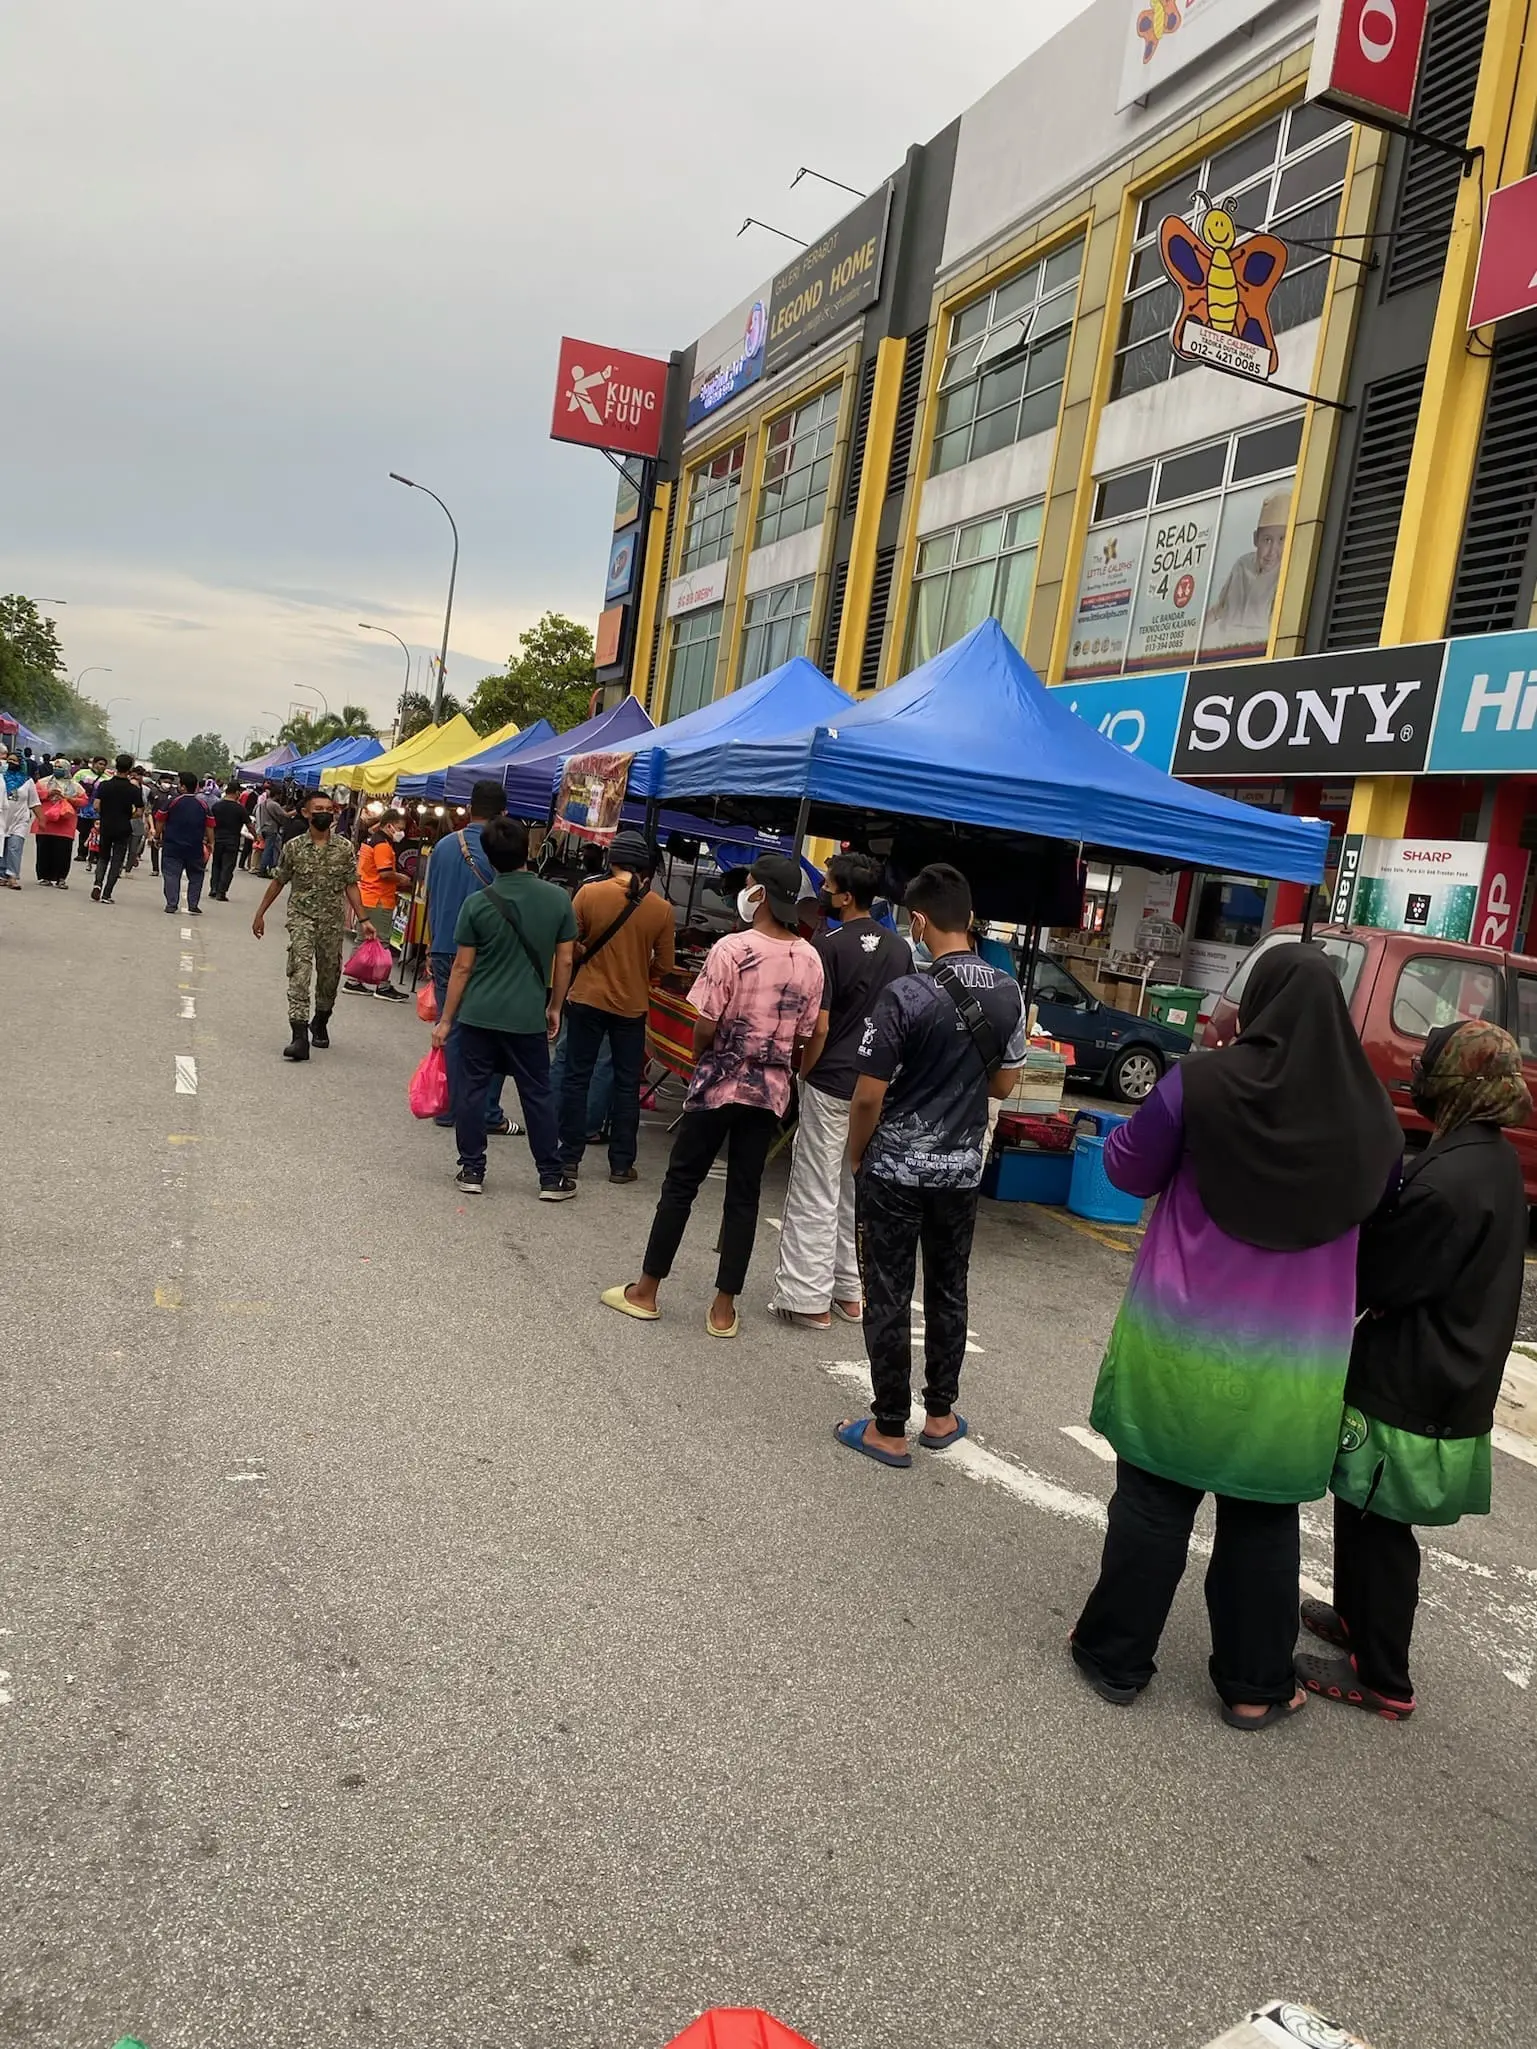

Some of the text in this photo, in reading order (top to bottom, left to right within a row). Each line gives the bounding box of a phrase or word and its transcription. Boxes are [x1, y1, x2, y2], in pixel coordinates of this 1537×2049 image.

[802, 231, 840, 273] PERABOT
[770, 279, 823, 340] LEGOND
[829, 236, 877, 296] HOME
[1200, 328, 1225, 342] LITTLE
[1190, 341, 1261, 375] 012- 421 0085
[606, 381, 656, 411] KUNG
[604, 400, 641, 425] FUU
[1156, 522, 1198, 549] READ
[1087, 565, 1107, 578] LITTLE
[1151, 543, 1207, 574] SOLAT
[1156, 574, 1169, 600] 4
[1160, 611, 1185, 623] BANDAR
[1172, 618, 1197, 630] KAJANG
[1402, 850, 1452, 862] SHARP
